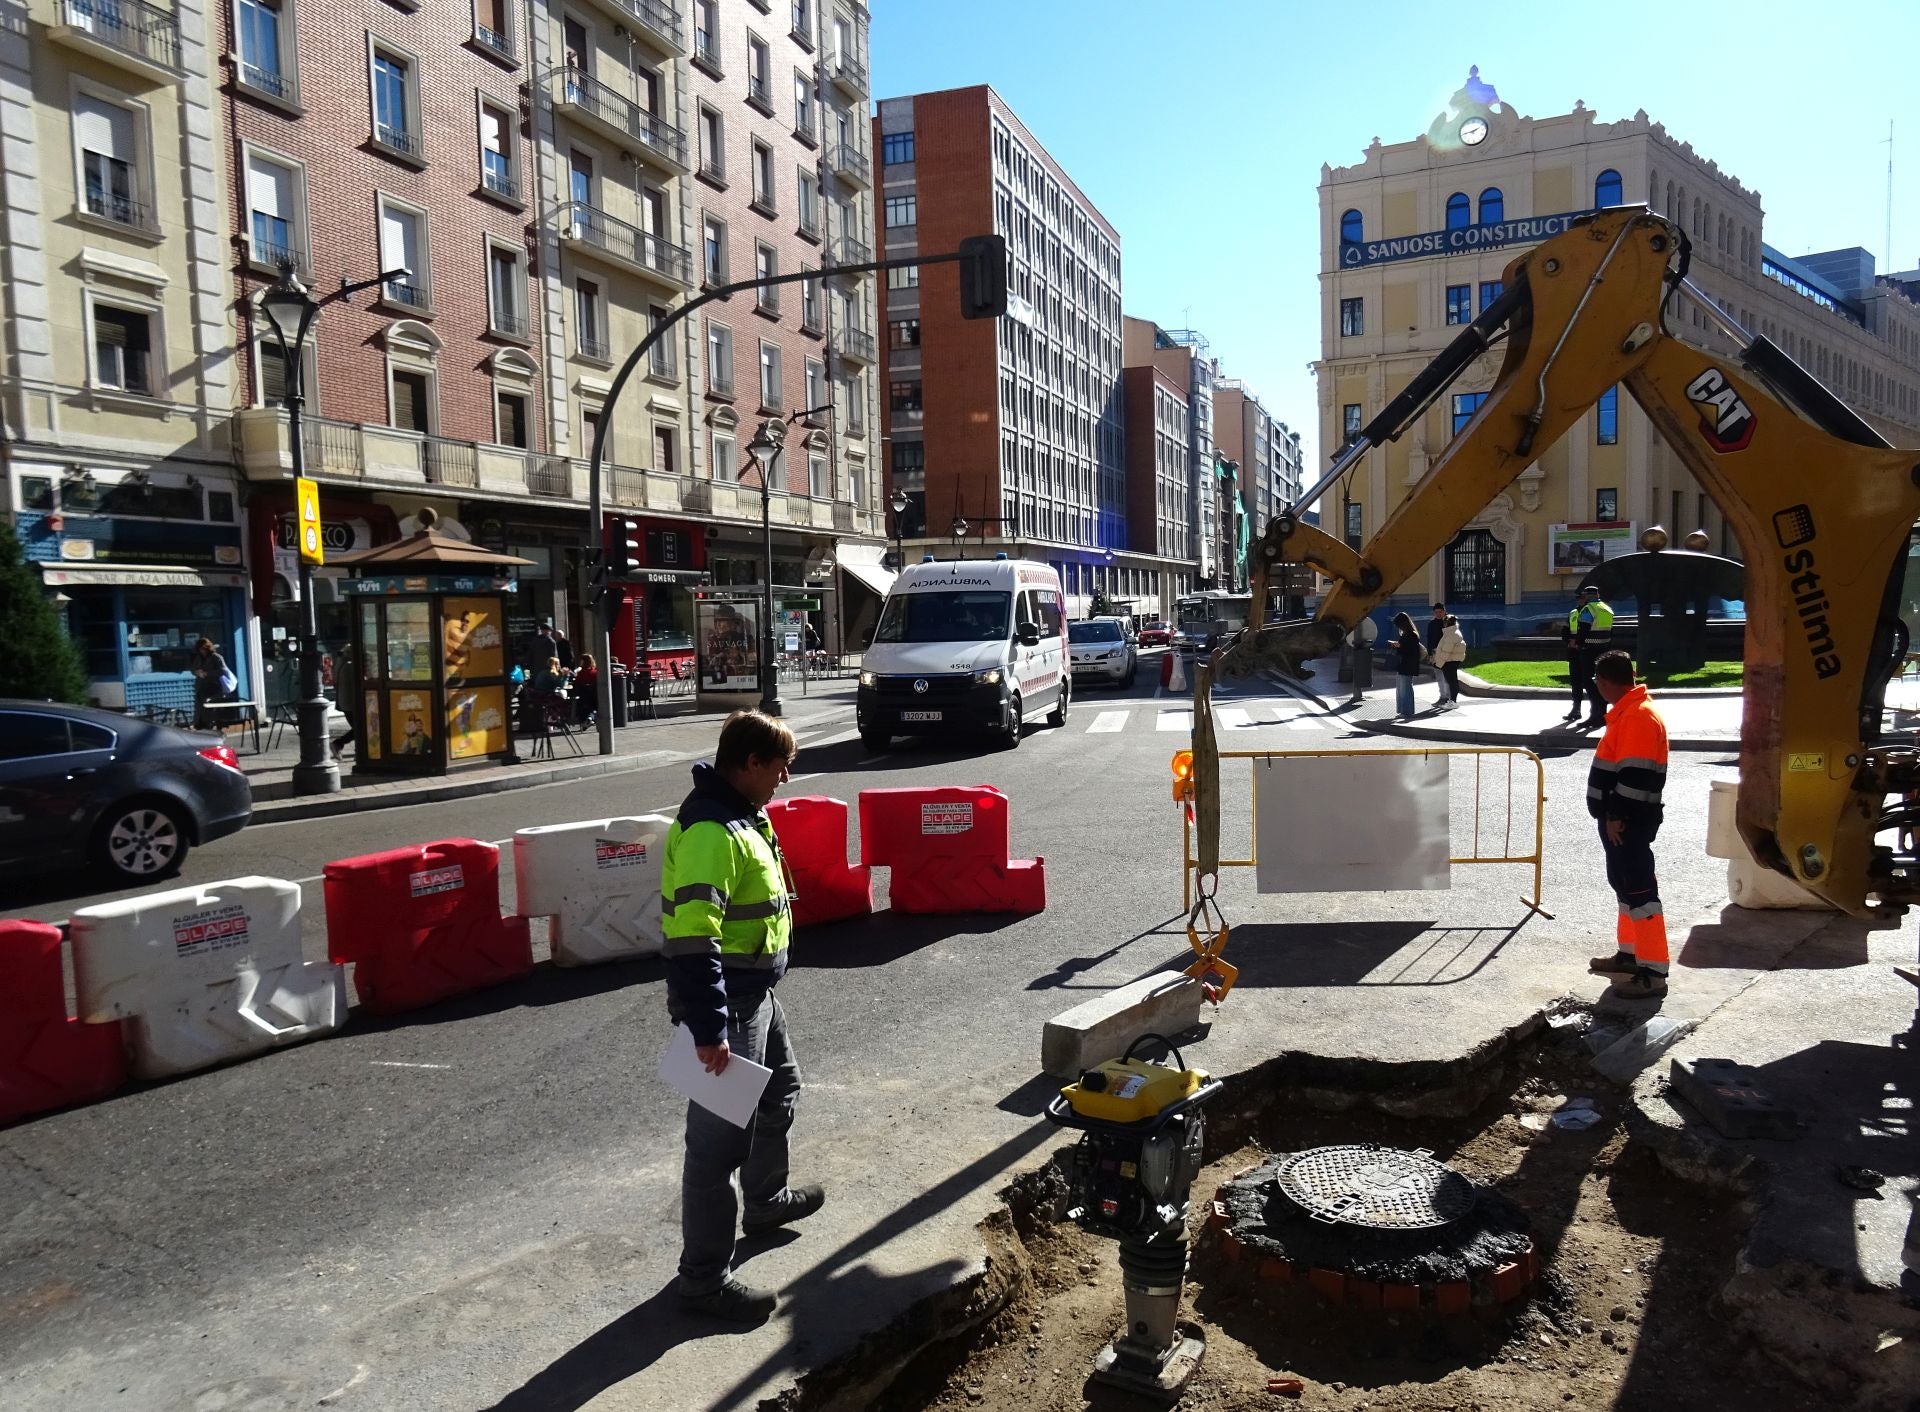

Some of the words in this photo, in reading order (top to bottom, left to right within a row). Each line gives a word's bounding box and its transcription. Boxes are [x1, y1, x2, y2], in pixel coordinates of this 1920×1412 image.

[1368, 235, 1444, 260] SANJOSE
[1451, 214, 1592, 247] CONSTRUCT
[1687, 368, 1752, 435] CAT
[97, 574, 117, 584] BAR
[125, 574, 160, 585] PLAZA
[166, 574, 208, 585] MADRID
[648, 573, 676, 583] ROMERO
[1784, 549, 1841, 680] Stlima
[706, 639, 748, 649] SAUVAGE
[905, 712, 924, 721] 3202
[925, 711, 941, 720] MJJ
[923, 814, 971, 822] BLAPE
[597, 845, 645, 856] BLAPE
[173, 911, 211, 924] ALQUILER
[219, 904, 244, 914] VENTA
[176, 920, 246, 942] BLAPE
